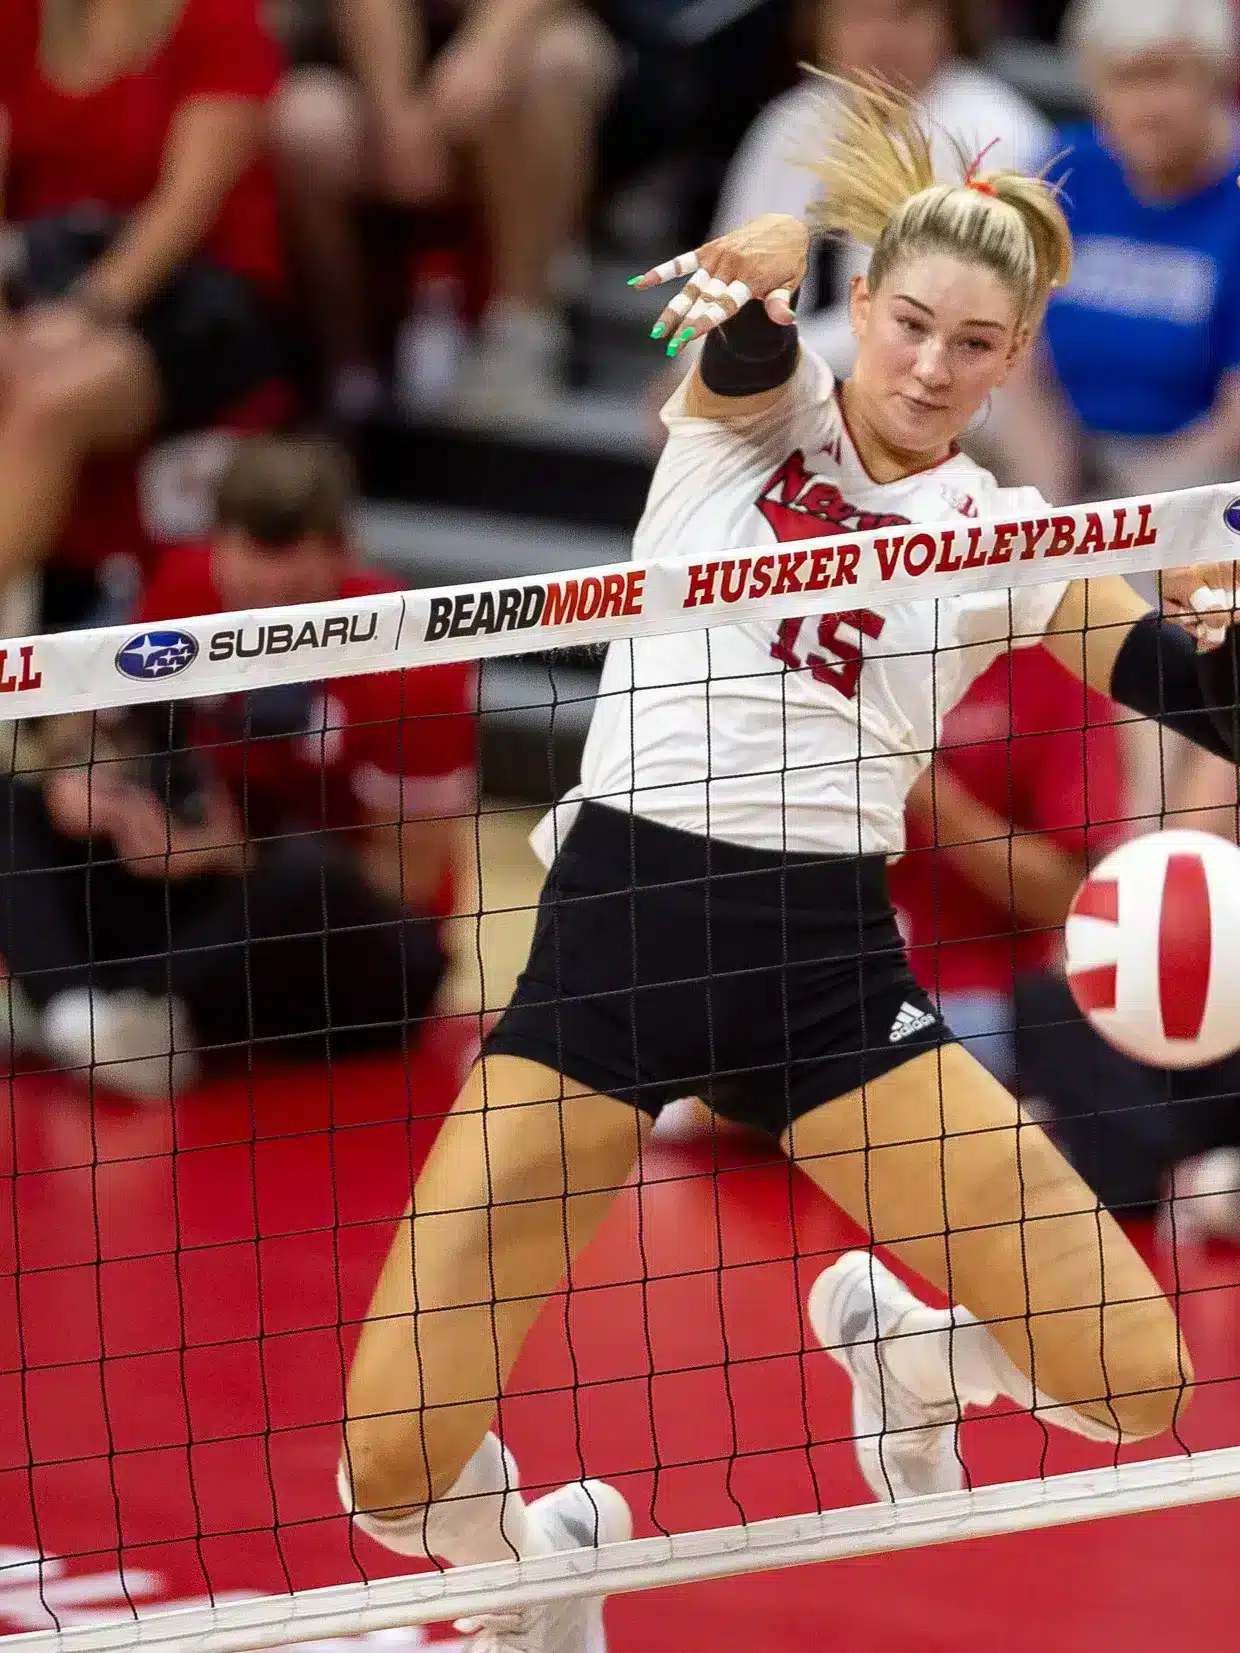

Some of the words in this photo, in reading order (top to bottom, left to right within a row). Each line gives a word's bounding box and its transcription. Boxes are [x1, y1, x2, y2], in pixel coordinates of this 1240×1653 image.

[209, 612, 376, 661] SUBARU
[424, 570, 646, 642] BEARDMORE
[683, 544, 862, 608] HUSKER
[873, 504, 1158, 581] VOLLEYBALL
[889, 1013, 936, 1042] adidas
